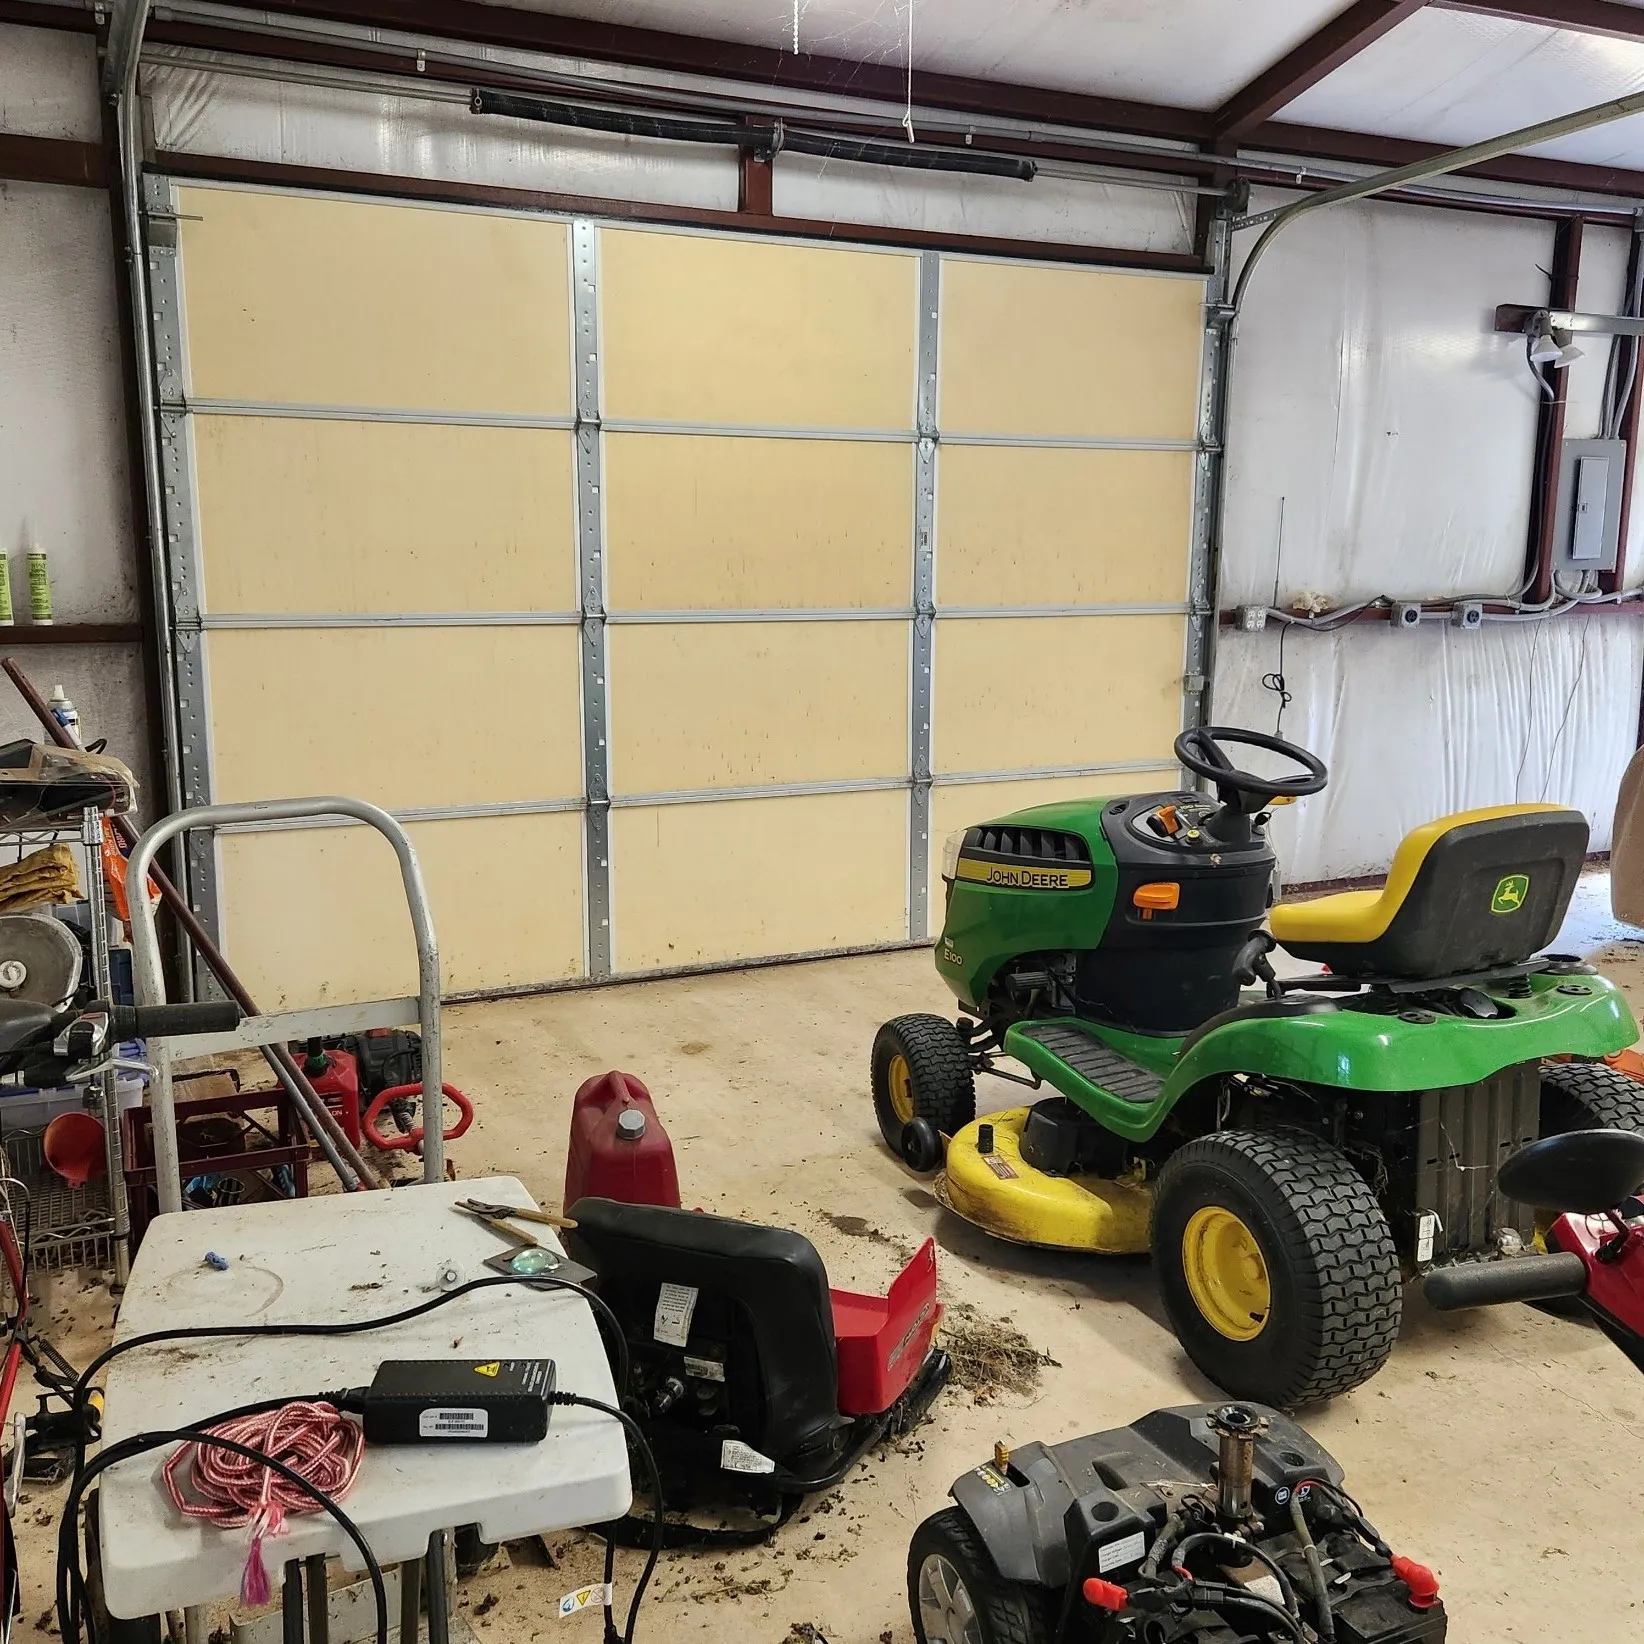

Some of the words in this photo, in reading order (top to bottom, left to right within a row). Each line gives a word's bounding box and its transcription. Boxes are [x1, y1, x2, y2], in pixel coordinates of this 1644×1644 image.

[986, 866, 1019, 885] JOHN
[1021, 870, 1069, 887] DEERE
[944, 948, 963, 966] E100
